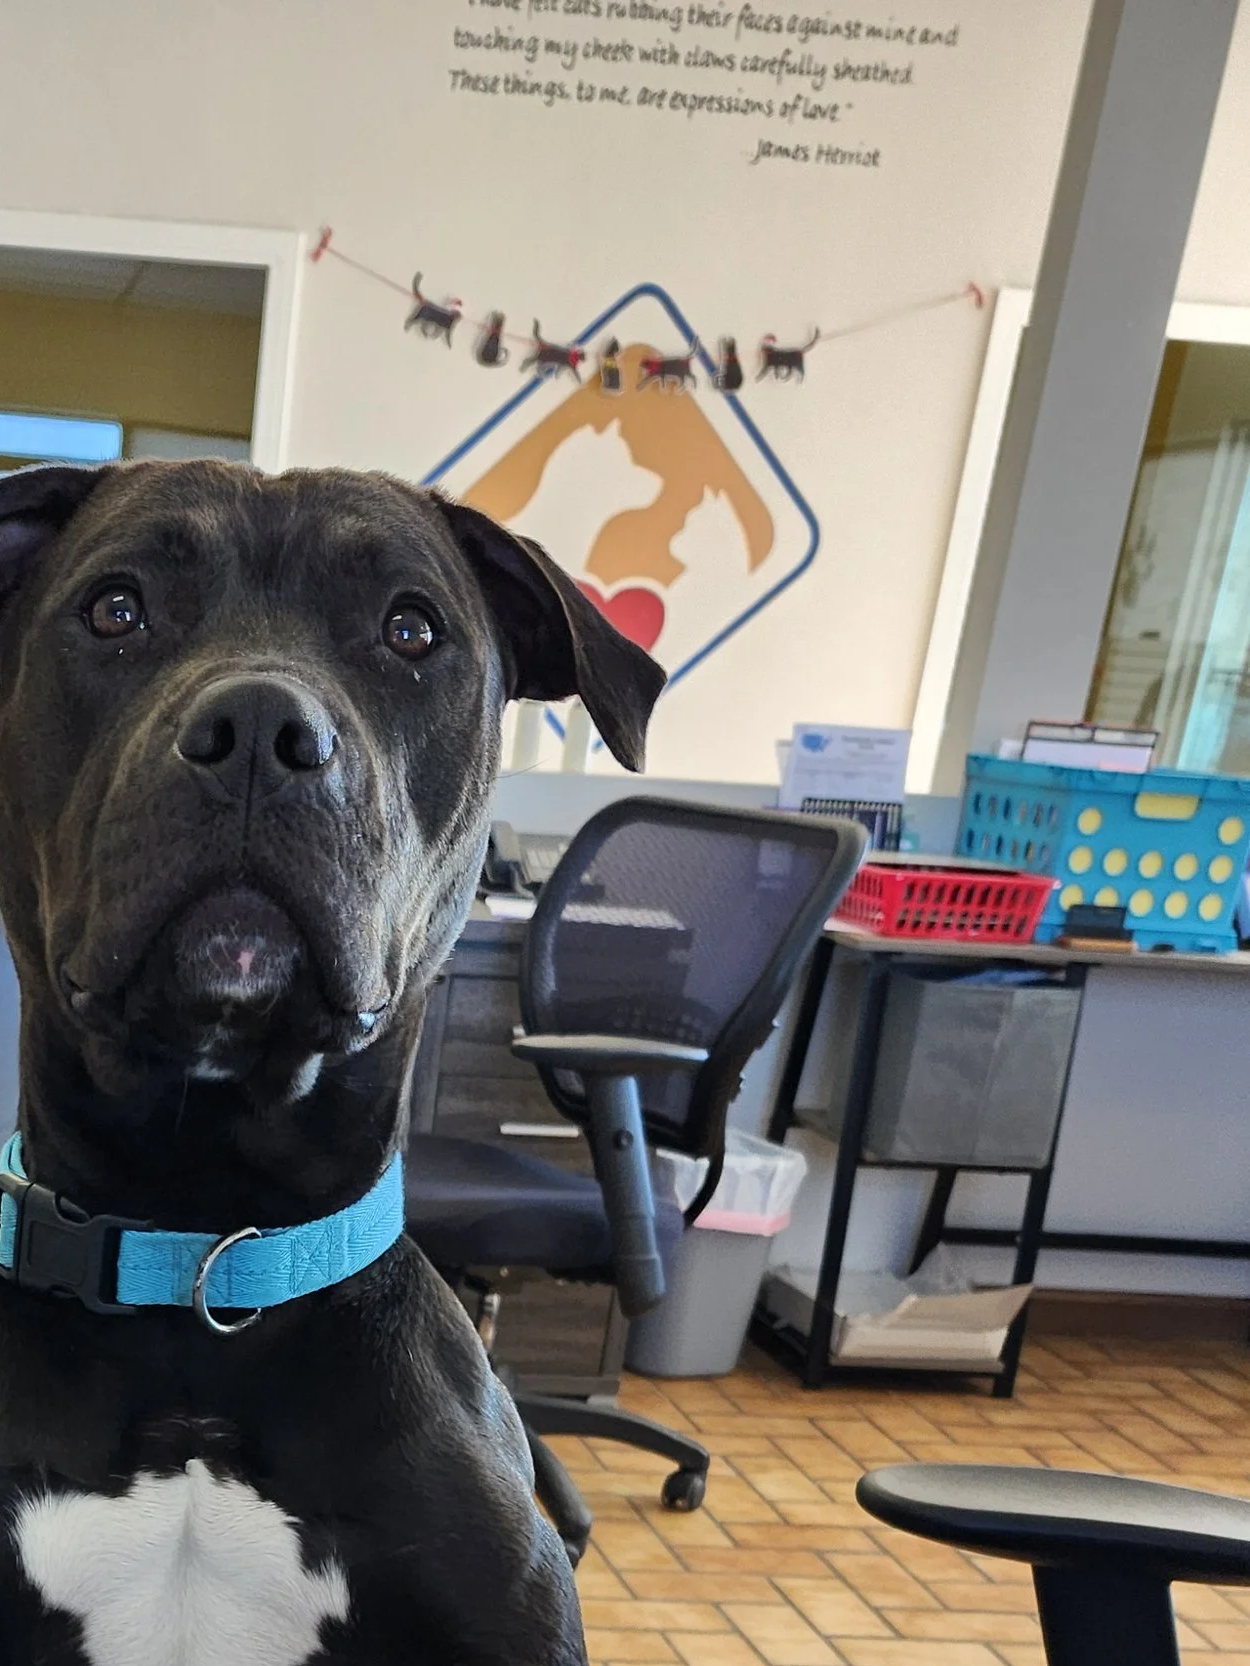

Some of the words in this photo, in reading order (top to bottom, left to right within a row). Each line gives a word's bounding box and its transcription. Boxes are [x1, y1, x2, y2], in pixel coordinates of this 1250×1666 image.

[562, 0, 603, 17] cats
[606, 0, 684, 33] rubbing
[687, 0, 733, 28] their
[735, 3, 783, 41] faces
[786, 9, 863, 44] against
[866, 16, 918, 45] mine
[918, 22, 962, 47] and
[453, 25, 540, 63] touching
[544, 39, 579, 71] my
[582, 37, 635, 63] cheek
[638, 38, 682, 66] with
[683, 44, 737, 72] claws
[740, 47, 828, 91] carefully
[448, 68, 501, 95] These
[576, 79, 597, 103] to
[636, 86, 668, 110] are
[669, 87, 774, 120] expressions
[779, 94, 803, 125] of
[749, 138, 810, 167] James
